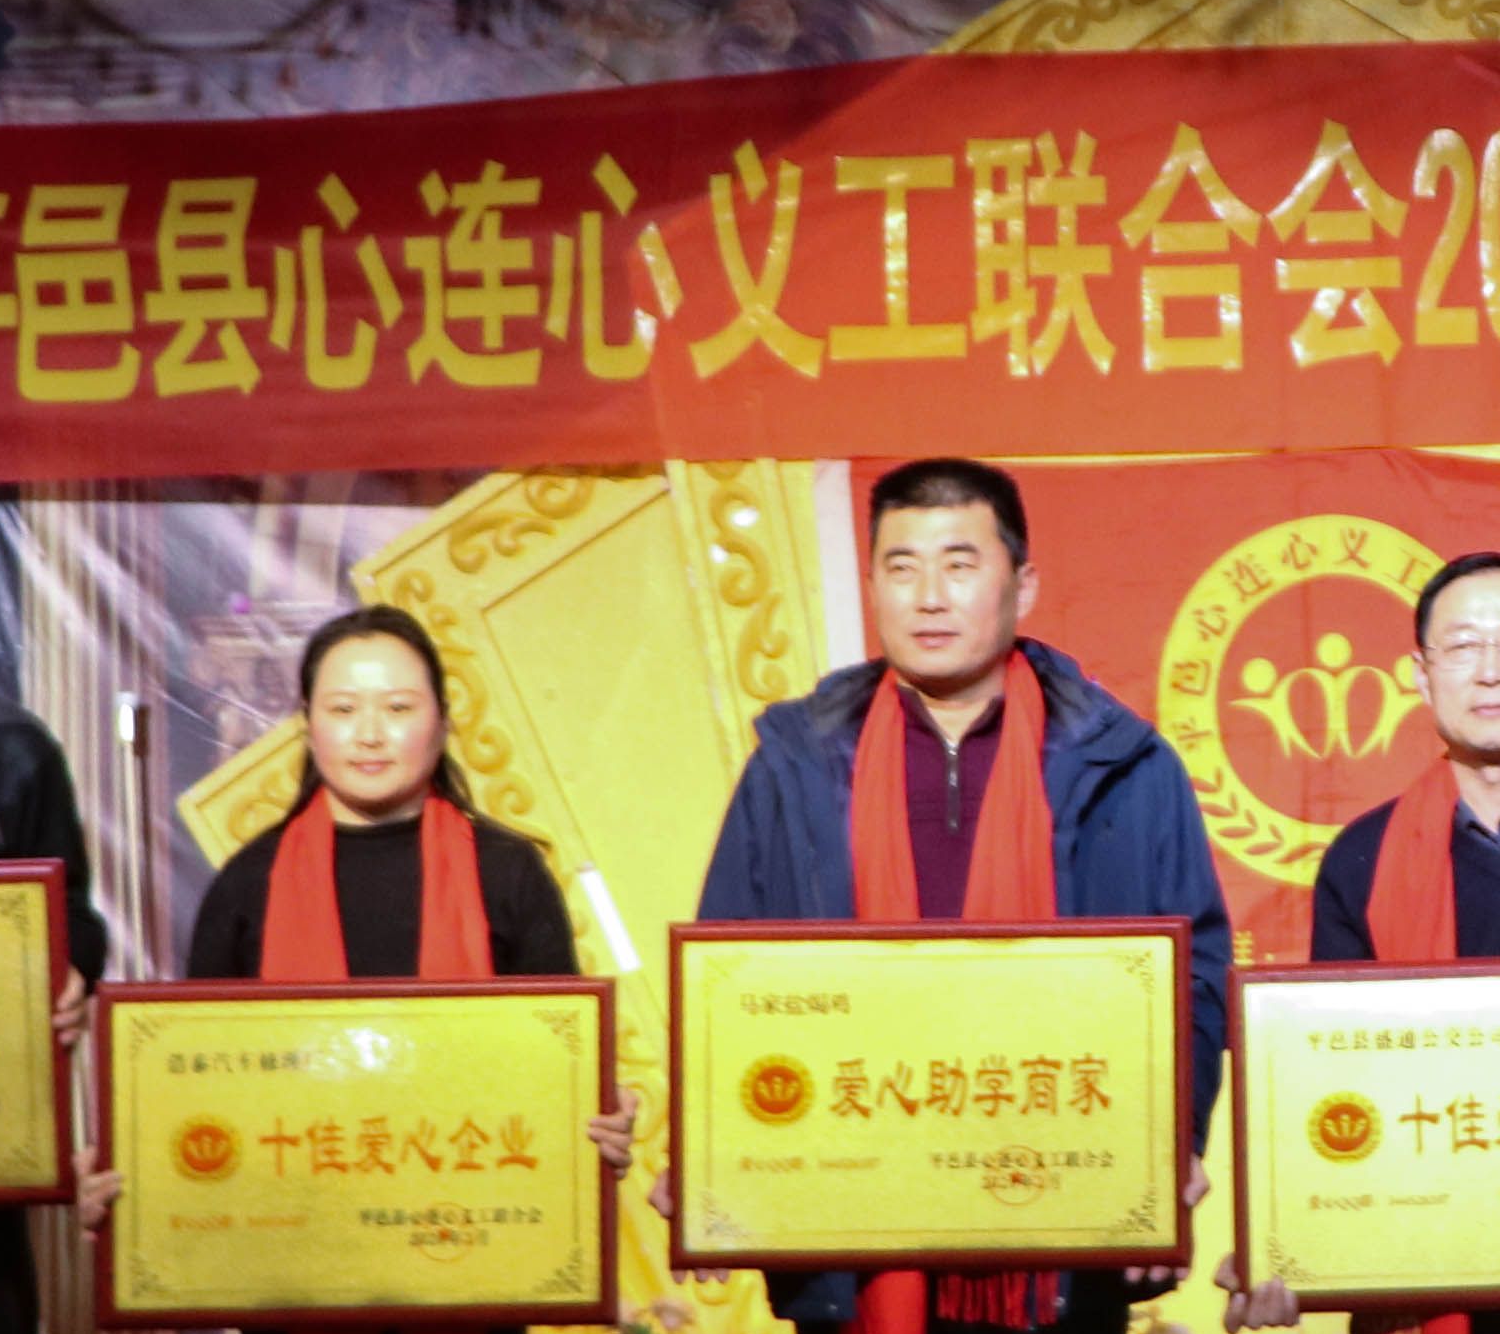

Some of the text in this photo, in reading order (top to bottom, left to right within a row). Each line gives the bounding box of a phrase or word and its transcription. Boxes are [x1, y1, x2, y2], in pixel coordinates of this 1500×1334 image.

[829, 1053, 1114, 1120] 爱心助学商家
[258, 1115, 540, 1178] 十佳爱心企业
